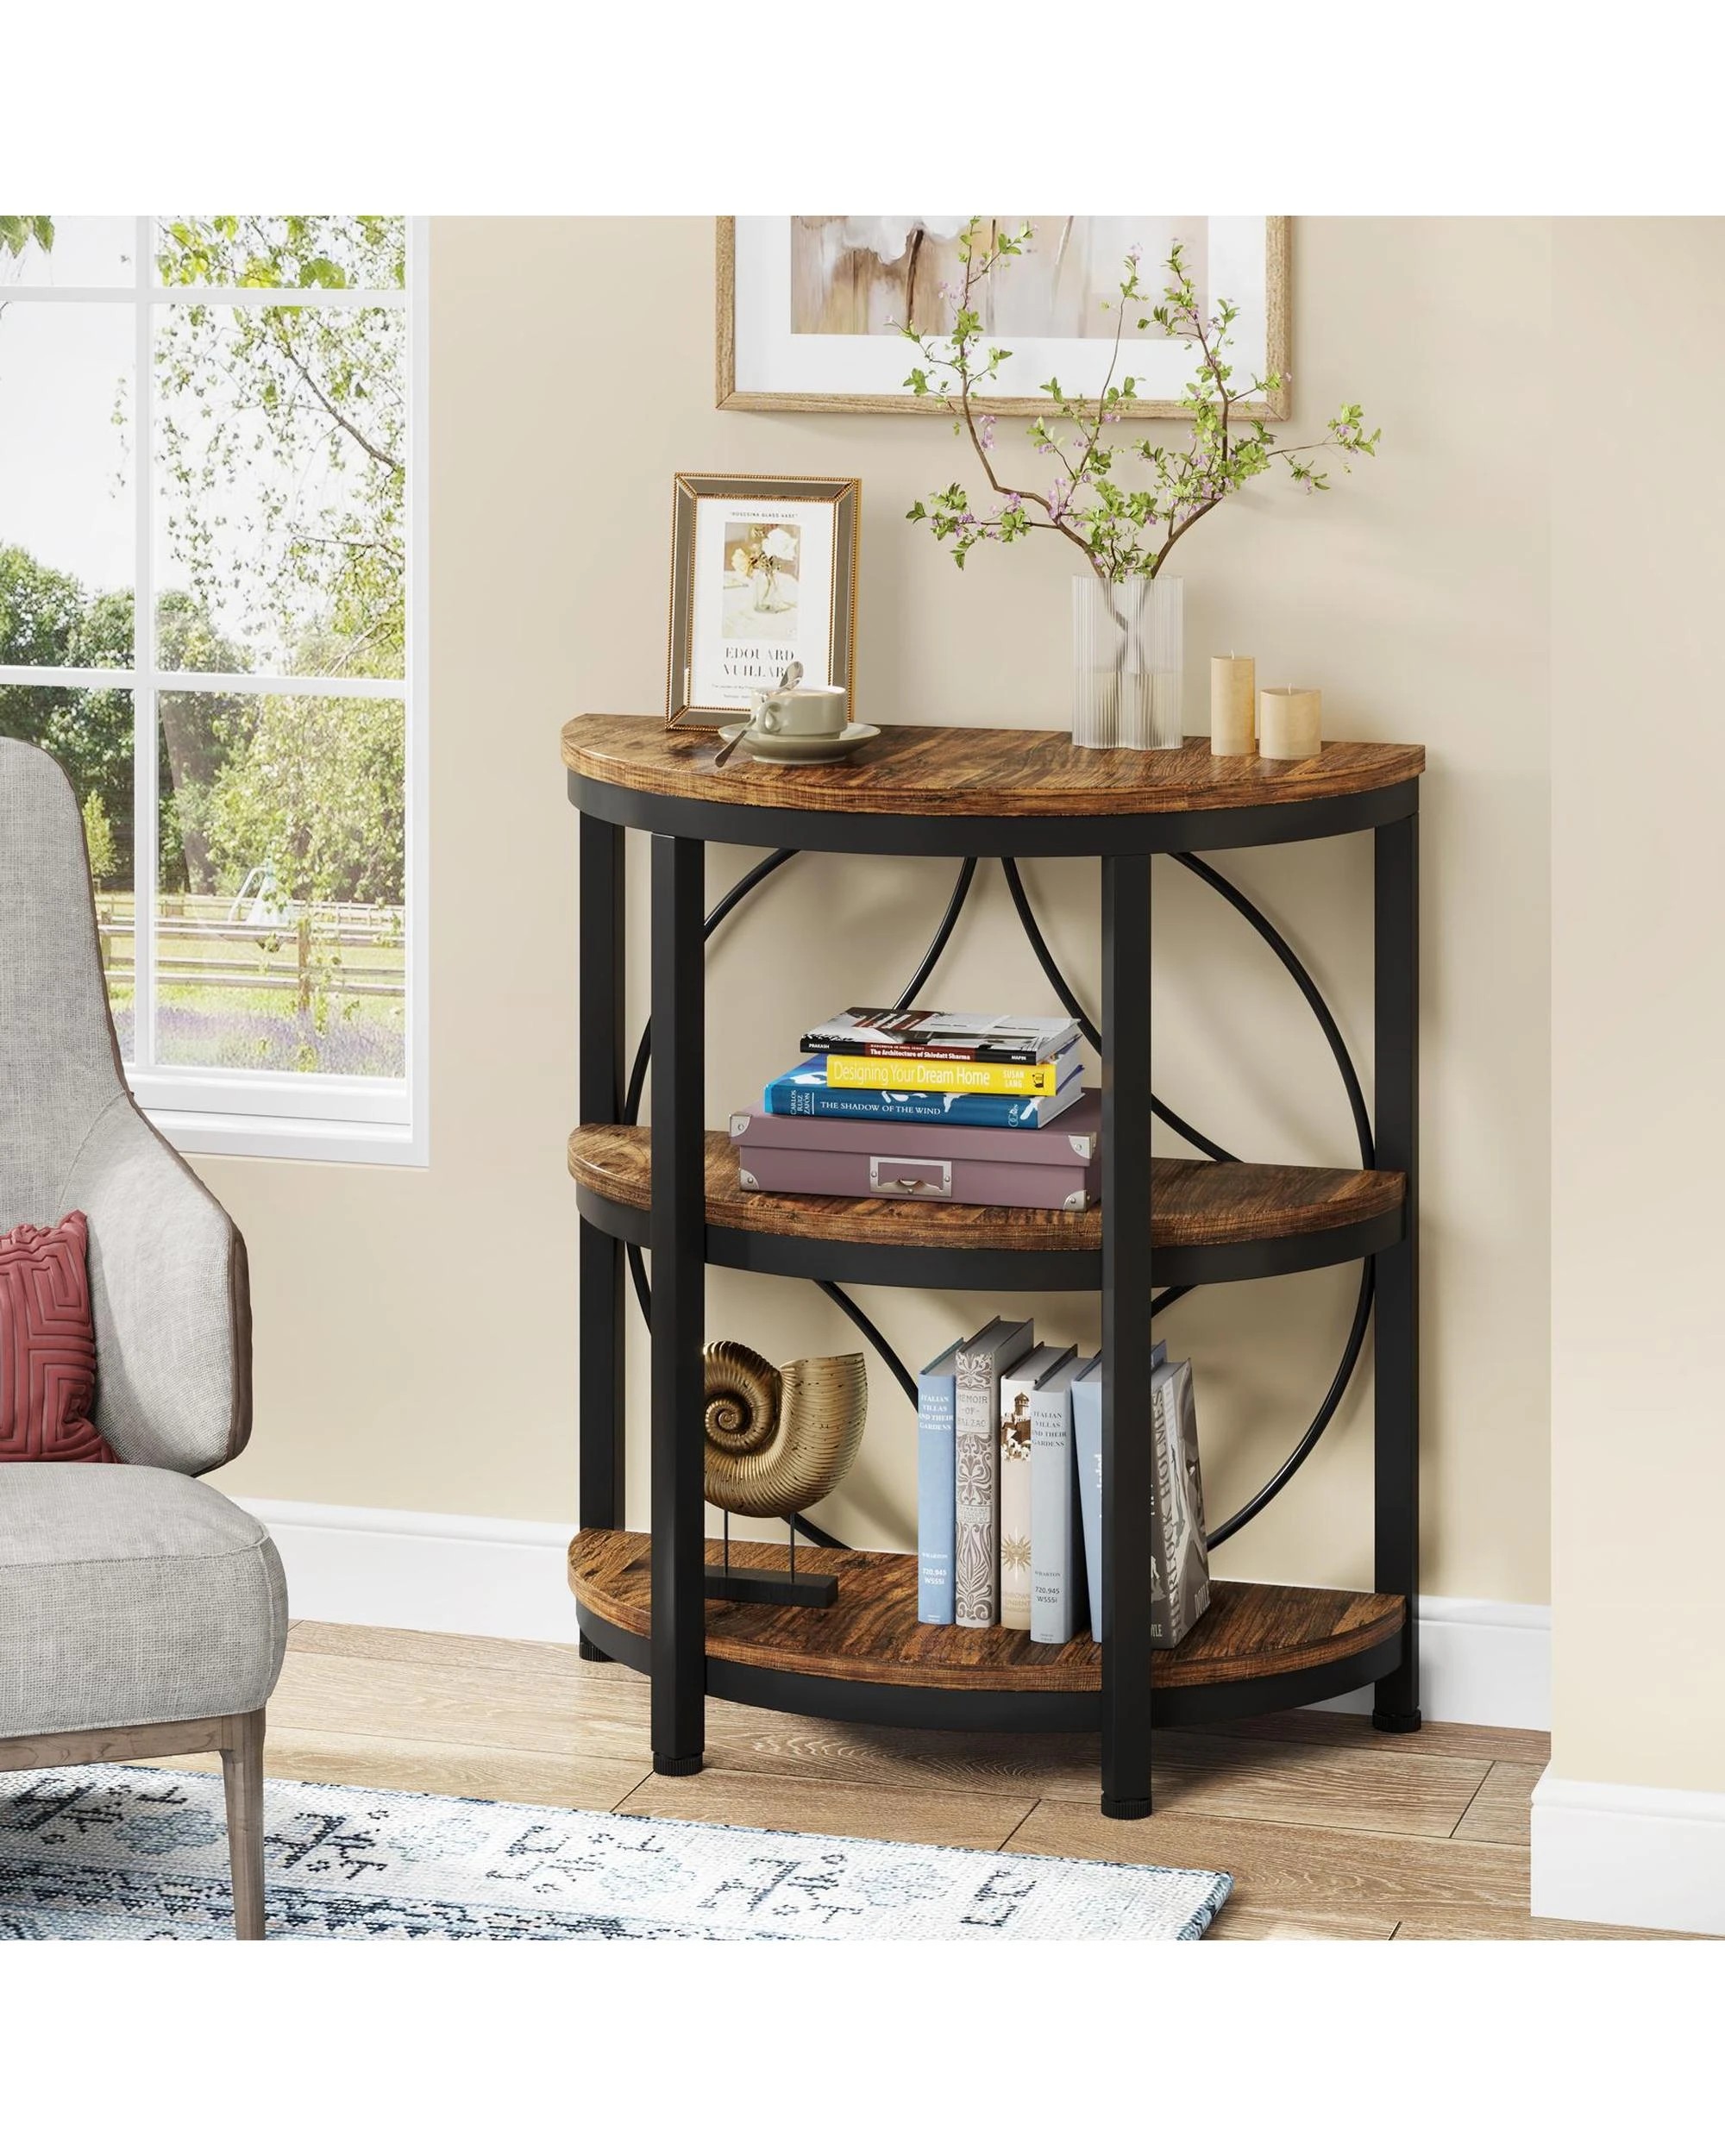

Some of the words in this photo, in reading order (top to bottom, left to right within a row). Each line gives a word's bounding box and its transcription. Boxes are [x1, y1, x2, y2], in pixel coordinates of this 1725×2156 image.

[725, 647, 794, 661] EDOUARD
[724, 663, 785, 678] VUILLAR
[881, 1049, 916, 1057] Architecture
[833, 1061, 889, 1086] Designing
[890, 1064, 915, 1082] Your
[917, 1065, 954, 1084] Dream
[957, 1067, 990, 1086] Home
[1003, 1069, 1025, 1079] SUSAN
[1005, 1079, 1023, 1088] LANG
[840, 1102, 879, 1111] SHADOW
[915, 1106, 941, 1115] WIND
[921, 1394, 949, 1402] ITALIAN
[919, 1422, 951, 1431] GARDENS
[1035, 1586, 1060, 1595] 720.945
[1151, 1624, 1163, 1637] YLE
